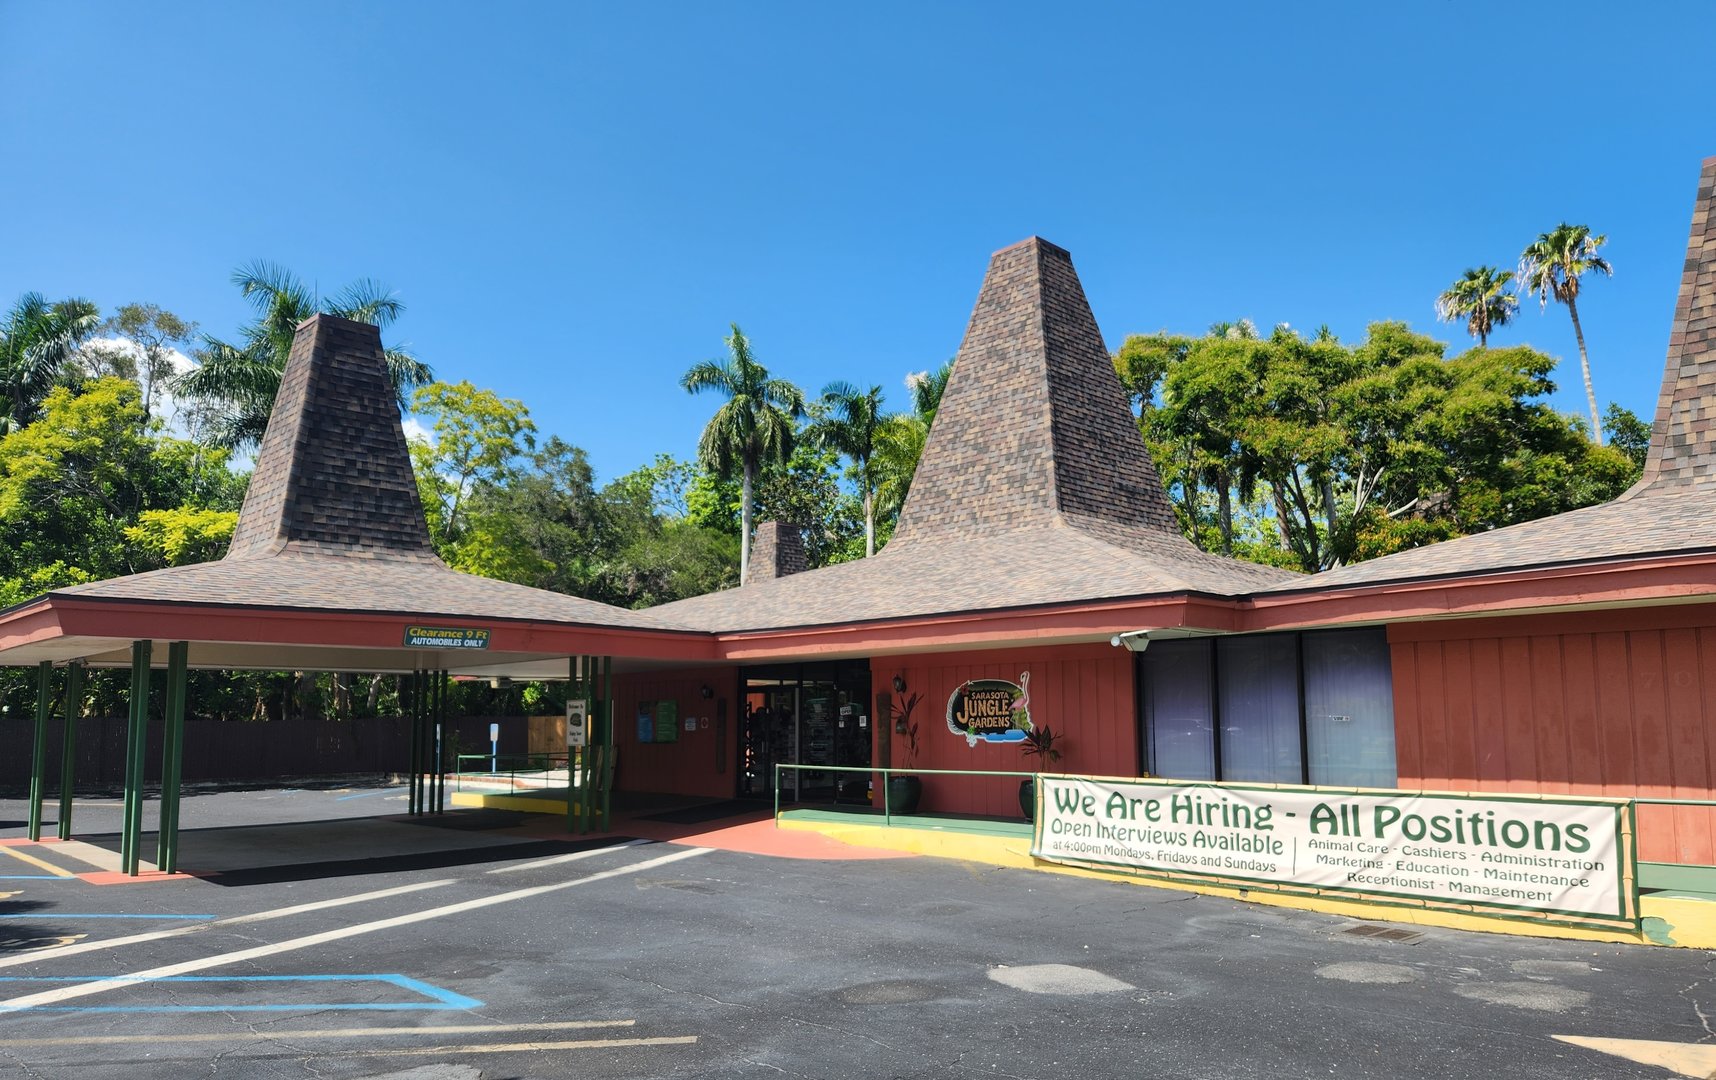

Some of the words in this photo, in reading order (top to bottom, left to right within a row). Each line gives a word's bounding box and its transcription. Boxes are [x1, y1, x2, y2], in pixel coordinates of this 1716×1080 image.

[409, 628, 463, 638] Clearance
[466, 630, 473, 639] 9
[476, 631, 487, 639] Ft
[411, 637, 462, 646] AUTOMOBILES
[464, 639, 483, 647] ONLY
[956, 696, 1010, 724] JUNGLE
[971, 691, 1010, 699] SARASOTA
[968, 716, 1010, 728] GARDENS
[1054, 787, 1095, 817] We
[1105, 791, 1162, 822] Are
[1171, 794, 1275, 831] Hiring
[1309, 802, 1362, 837] All
[1374, 805, 1591, 854] Positions
[1051, 818, 1092, 837] Open
[1096, 821, 1188, 847] Interviews
[1193, 830, 1284, 856] Available
[1053, 840, 1063, 850] at
[1064, 841, 1101, 855] 4:00pm
[1157, 850, 1198, 866] Fridays
[1200, 854, 1221, 867] and
[1224, 857, 1277, 874] Sundays
[1308, 838, 1353, 853] Animal
[1356, 842, 1389, 855] Care
[1401, 845, 1467, 861] Cashiers
[1480, 851, 1605, 872] Administration
[1316, 854, 1384, 870] Marketing
[1396, 860, 1470, 877] Education
[1483, 868, 1590, 888] Maintenance
[1347, 872, 1435, 890] Receptionist
[1448, 881, 1553, 902] Management
